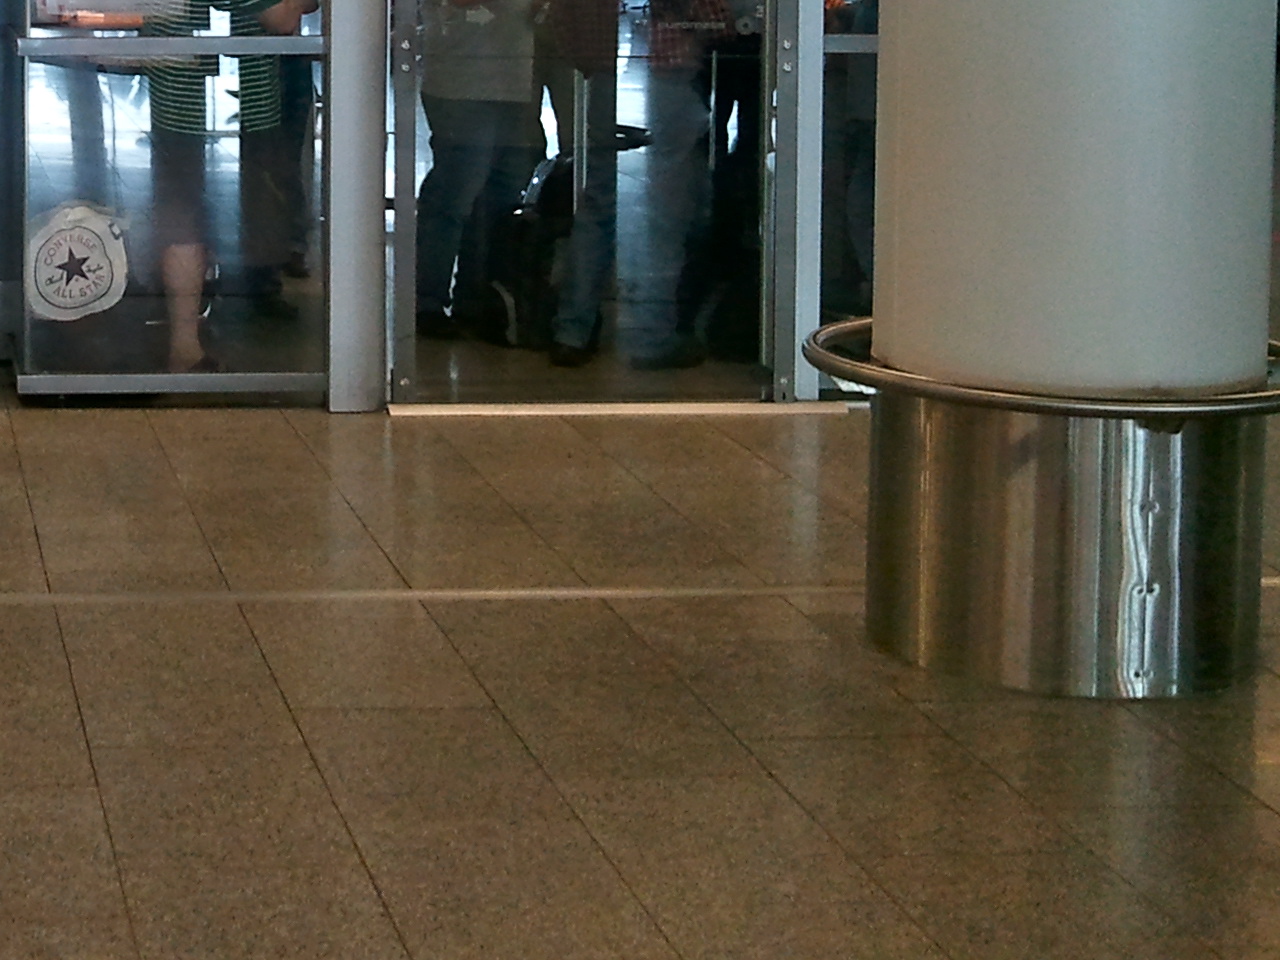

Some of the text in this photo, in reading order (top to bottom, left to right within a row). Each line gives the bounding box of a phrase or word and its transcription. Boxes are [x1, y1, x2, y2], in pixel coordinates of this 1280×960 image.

[43, 234, 98, 267] CONVERSE
[52, 285, 76, 299] ALL
[79, 274, 106, 298] STAR
